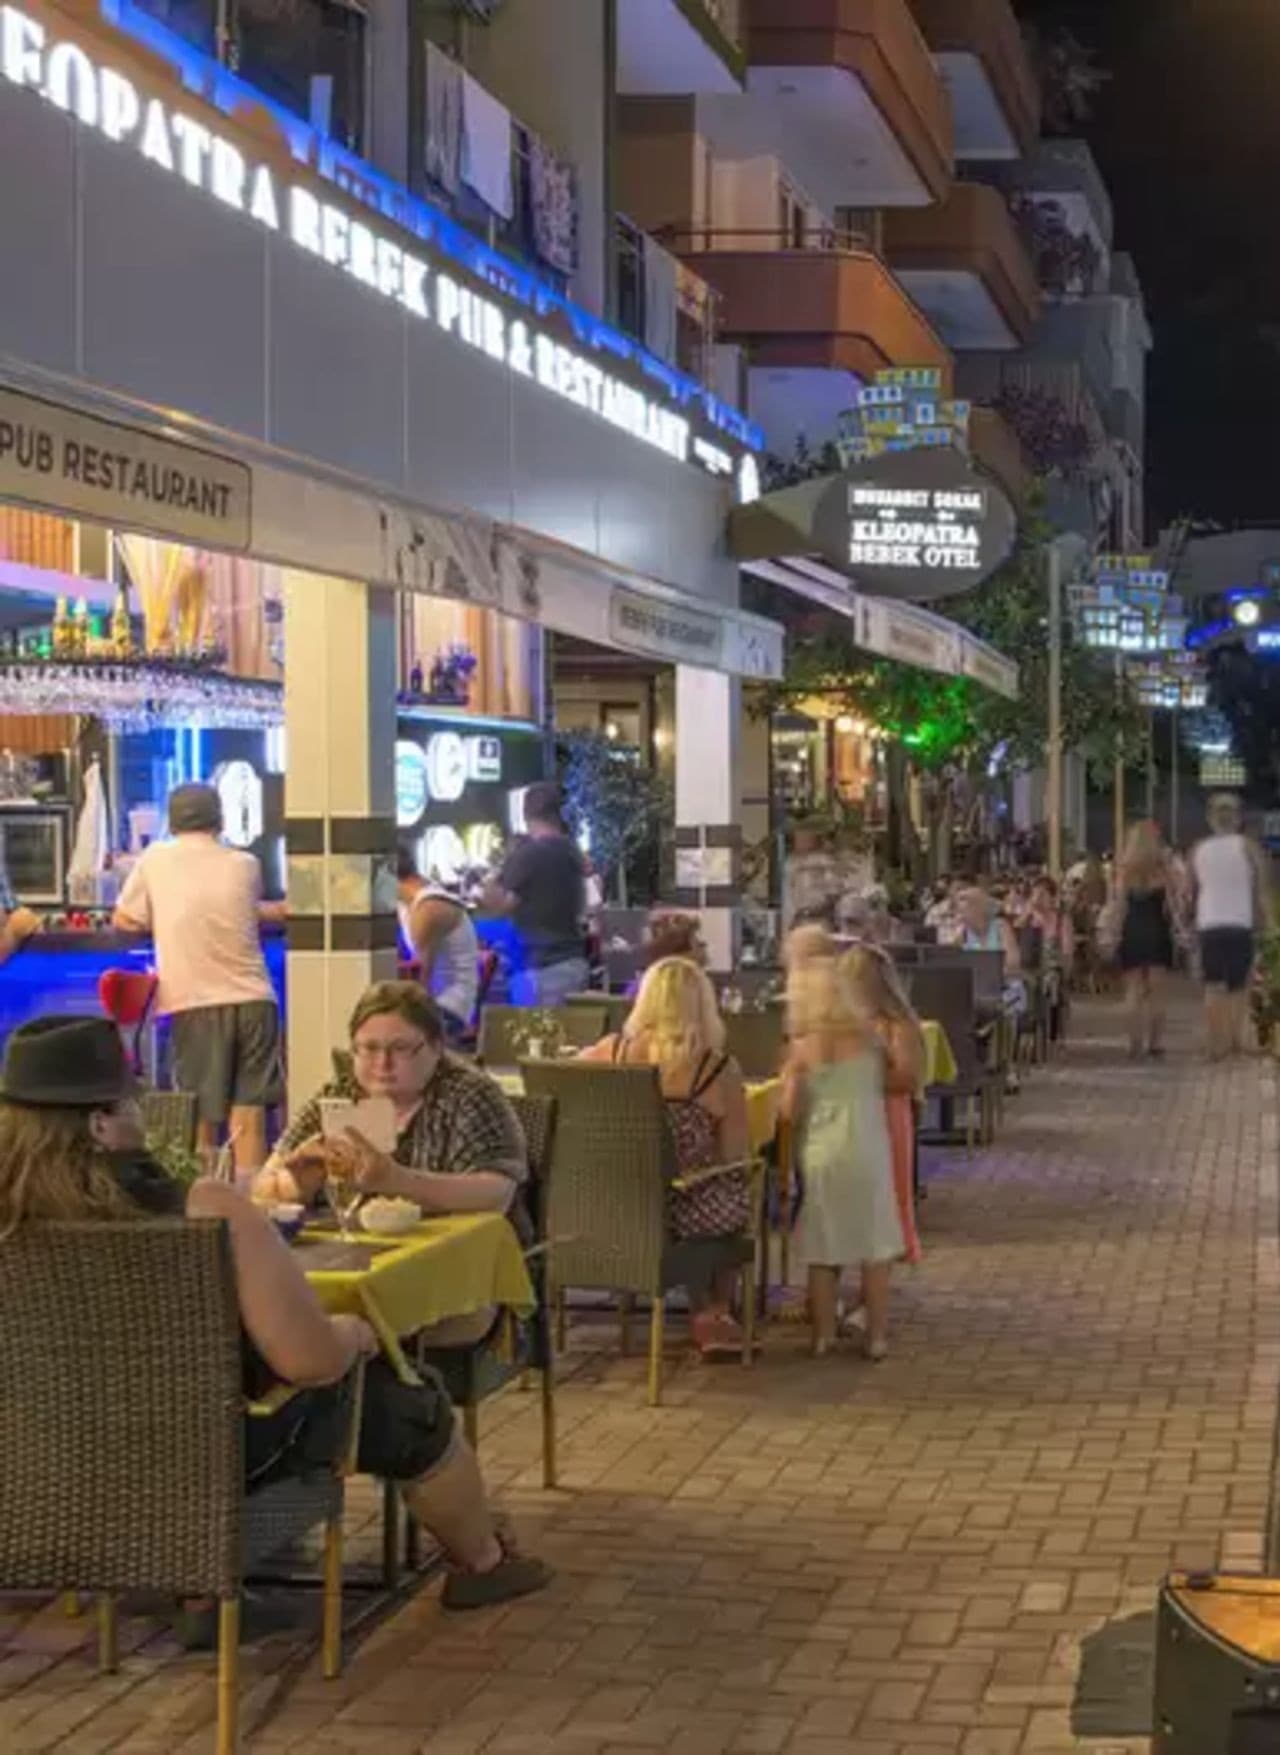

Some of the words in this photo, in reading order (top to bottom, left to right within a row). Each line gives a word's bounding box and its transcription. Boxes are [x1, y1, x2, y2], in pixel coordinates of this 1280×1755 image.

[436, 272, 505, 363] PUB
[509, 318, 534, 379] &
[535, 332, 690, 463] RESTAURANT
[0, 421, 54, 475] PUB
[63, 441, 234, 519] RESTAURANT
[849, 541, 921, 568] BEBEK
[923, 547, 982, 570] OTEL
[852, 520, 980, 547] KLEOPATRA
